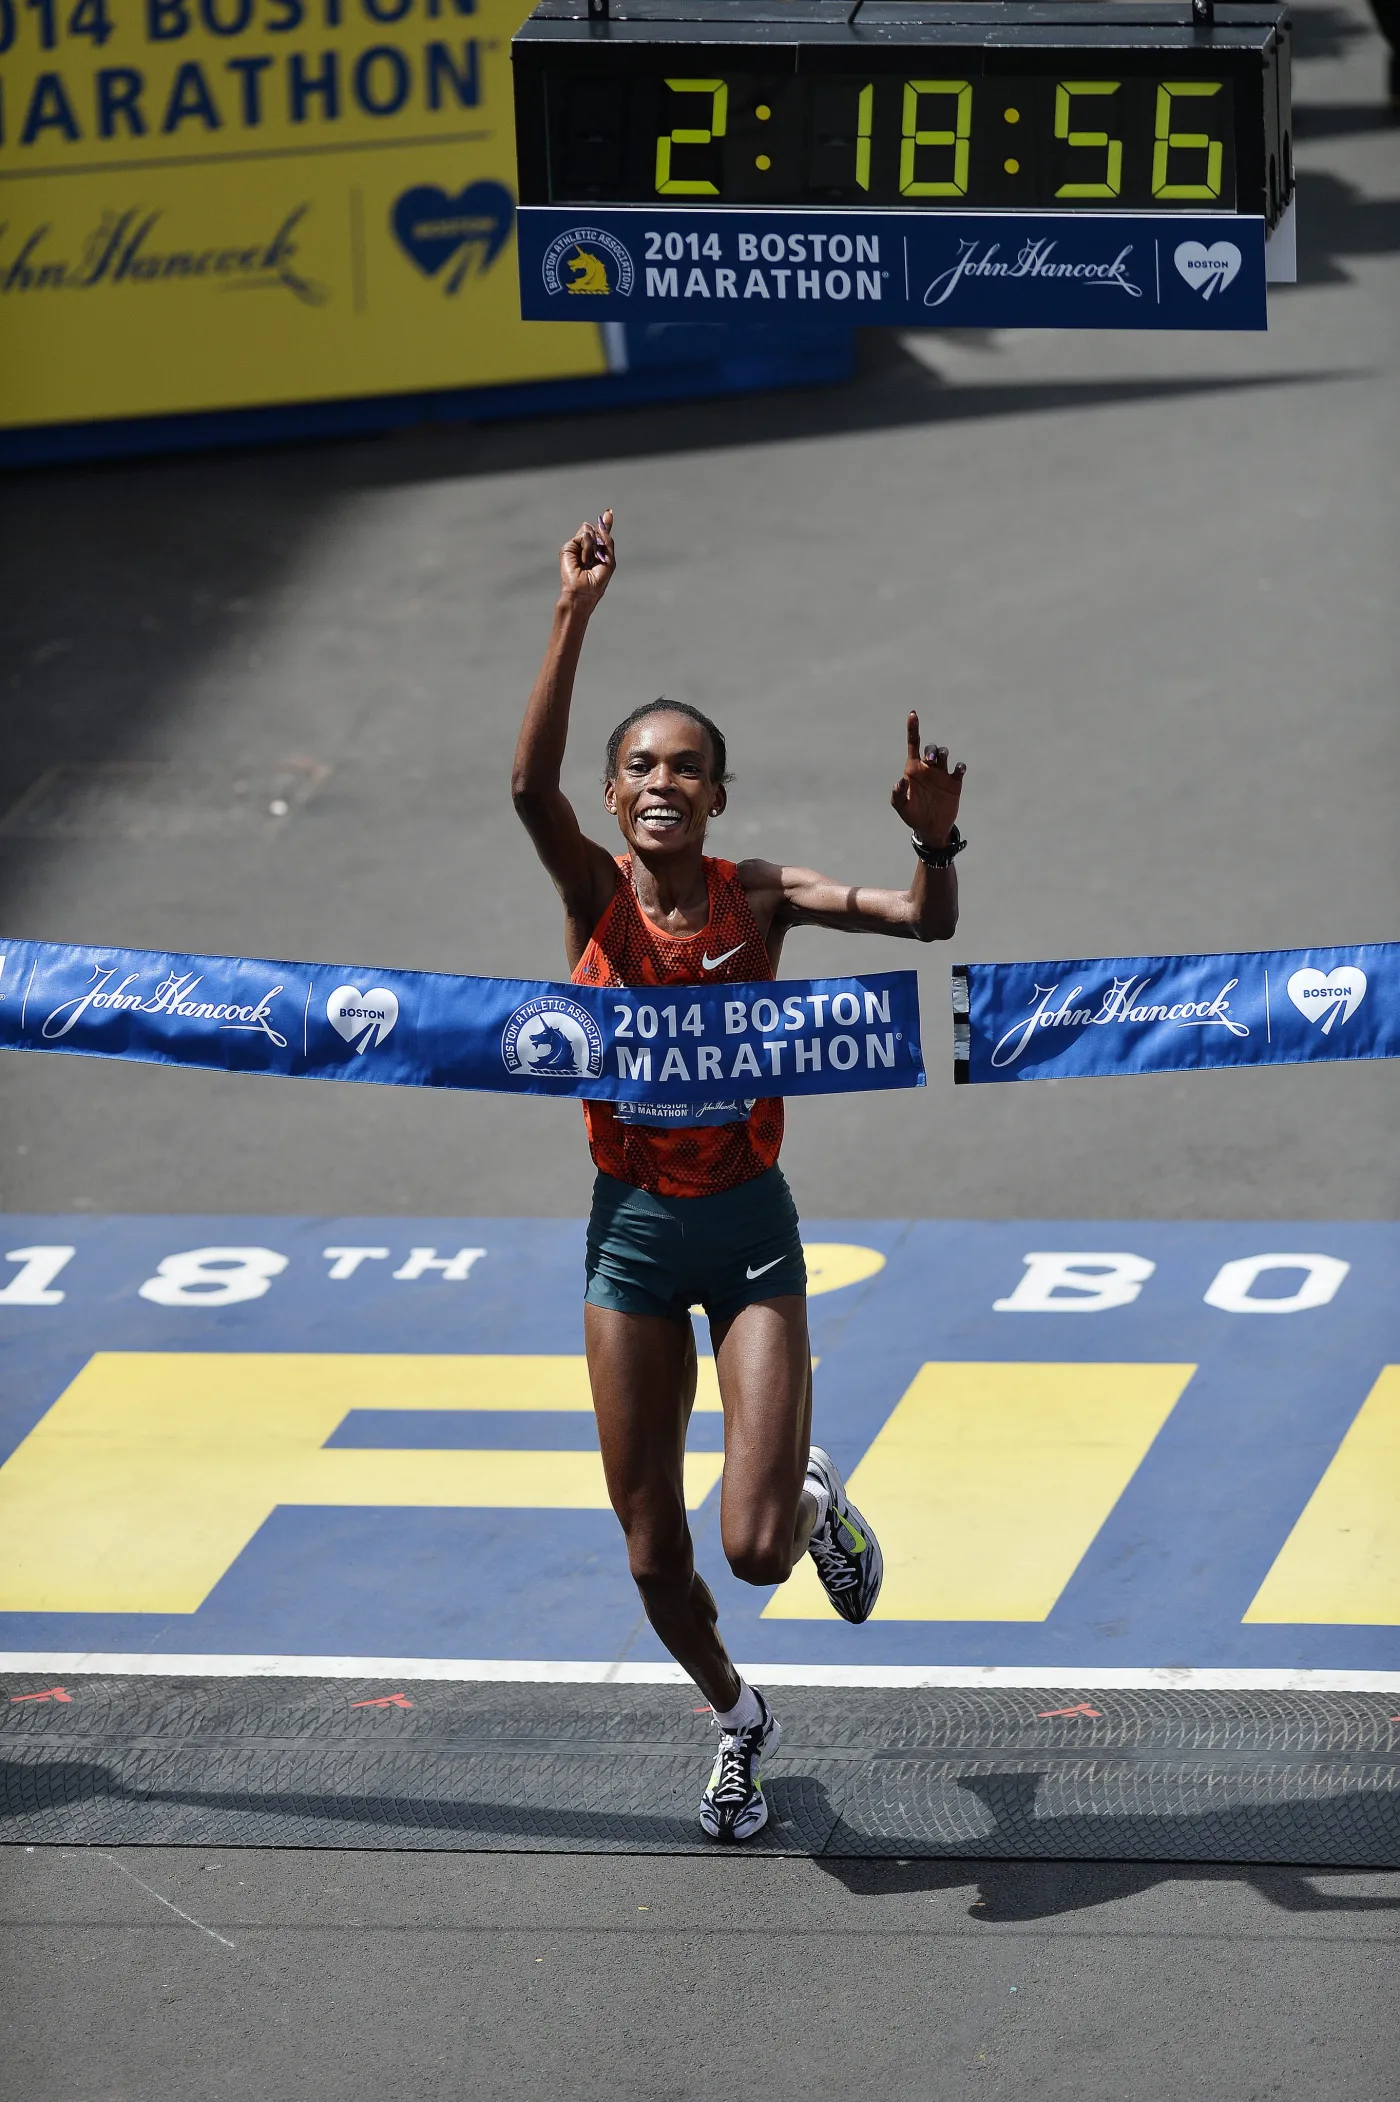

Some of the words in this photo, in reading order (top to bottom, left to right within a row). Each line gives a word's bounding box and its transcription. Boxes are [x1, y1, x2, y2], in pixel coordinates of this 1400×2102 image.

[0, 37, 483, 147] ARATHON
[655, 79, 1223, 198] 2:18:56
[546, 252, 558, 290] BOSTON
[554, 230, 597, 253] ATHLETIC
[598, 233, 631, 290] ASSOCIATION
[644, 231, 722, 262] 2014
[739, 233, 880, 264] BOSTON
[924, 238, 1009, 306] John
[1008, 237, 1143, 297] Hancock
[1187, 260, 1229, 269] BOSTON
[645, 267, 882, 301] MARATHON
[42, 964, 143, 1039] John
[140, 970, 288, 1048] Hancock
[339, 1007, 386, 1021] BOSTON
[614, 1003, 705, 1039] 2014
[724, 990, 892, 1034] BOSTON
[1303, 985, 1352, 998] BOSTON
[505, 1023, 520, 1067] BOSTON
[515, 1000, 566, 1024] ATHLETIC
[566, 1004, 601, 1071] ASSOCIATION
[991, 983, 1094, 1067] John
[1091, 975, 1250, 1037] Hancock
[615, 1033, 897, 1082] MARATHON
[638, 1107, 688, 1117] MARATHON
